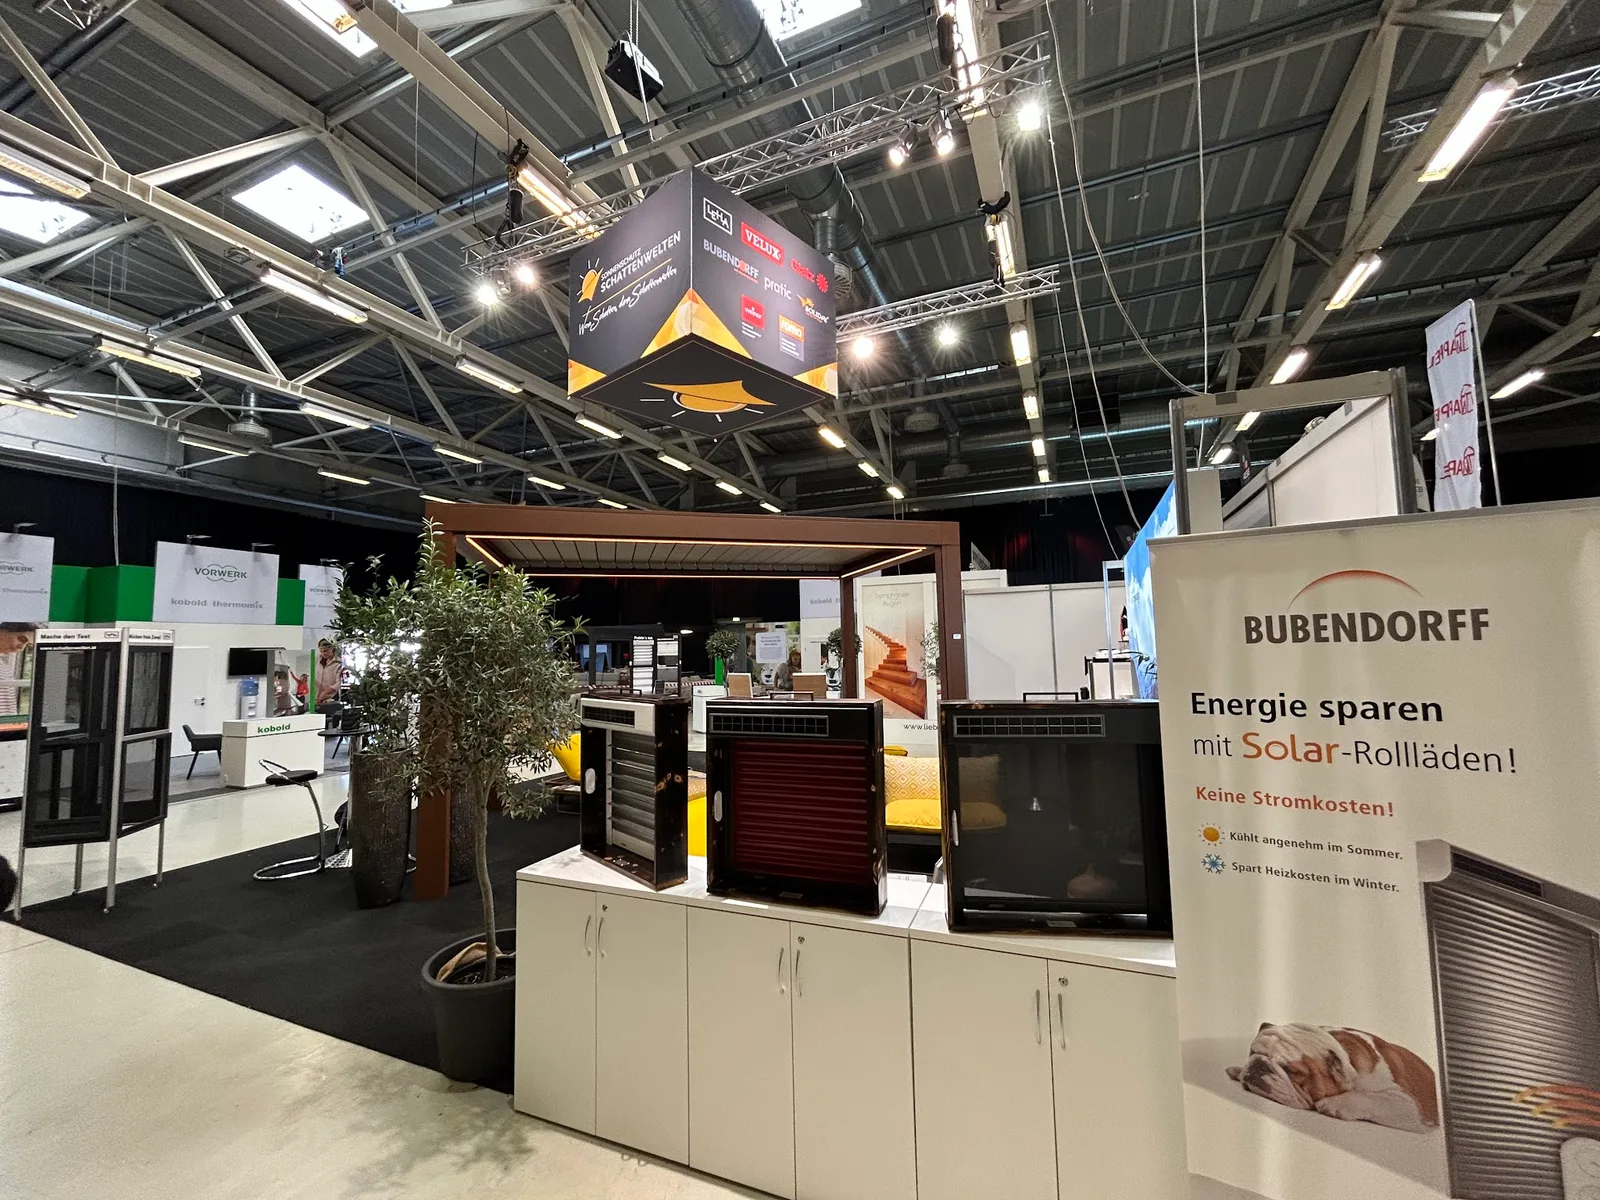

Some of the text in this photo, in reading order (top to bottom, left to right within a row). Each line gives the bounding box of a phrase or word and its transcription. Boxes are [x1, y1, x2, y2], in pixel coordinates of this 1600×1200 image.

[703, 239, 759, 279] BUBENDORFF
[745, 229, 781, 261] VELUX
[600, 231, 681, 293] SCHATTENWELTEN
[600, 247, 642, 281] SONNENSCHUTZ
[764, 277, 792, 300] pratic
[194, 567, 248, 580] VORWERK
[170, 597, 264, 610] kobold thermomix
[1243, 607, 1490, 645] BUBENDORFF
[1191, 692, 1444, 726] Energie sparen
[257, 723, 291, 735] kobold
[903, 723, 939, 731] www.lieb
[1193, 731, 1518, 774] mit Solar-Rollläden!
[1195, 786, 1394, 818] Keine Stromkosten!
[1229, 831, 1404, 860] Kühlt angenehm im Sommer.
[1231, 860, 1400, 893] Spart Heizkosten im Winter.
